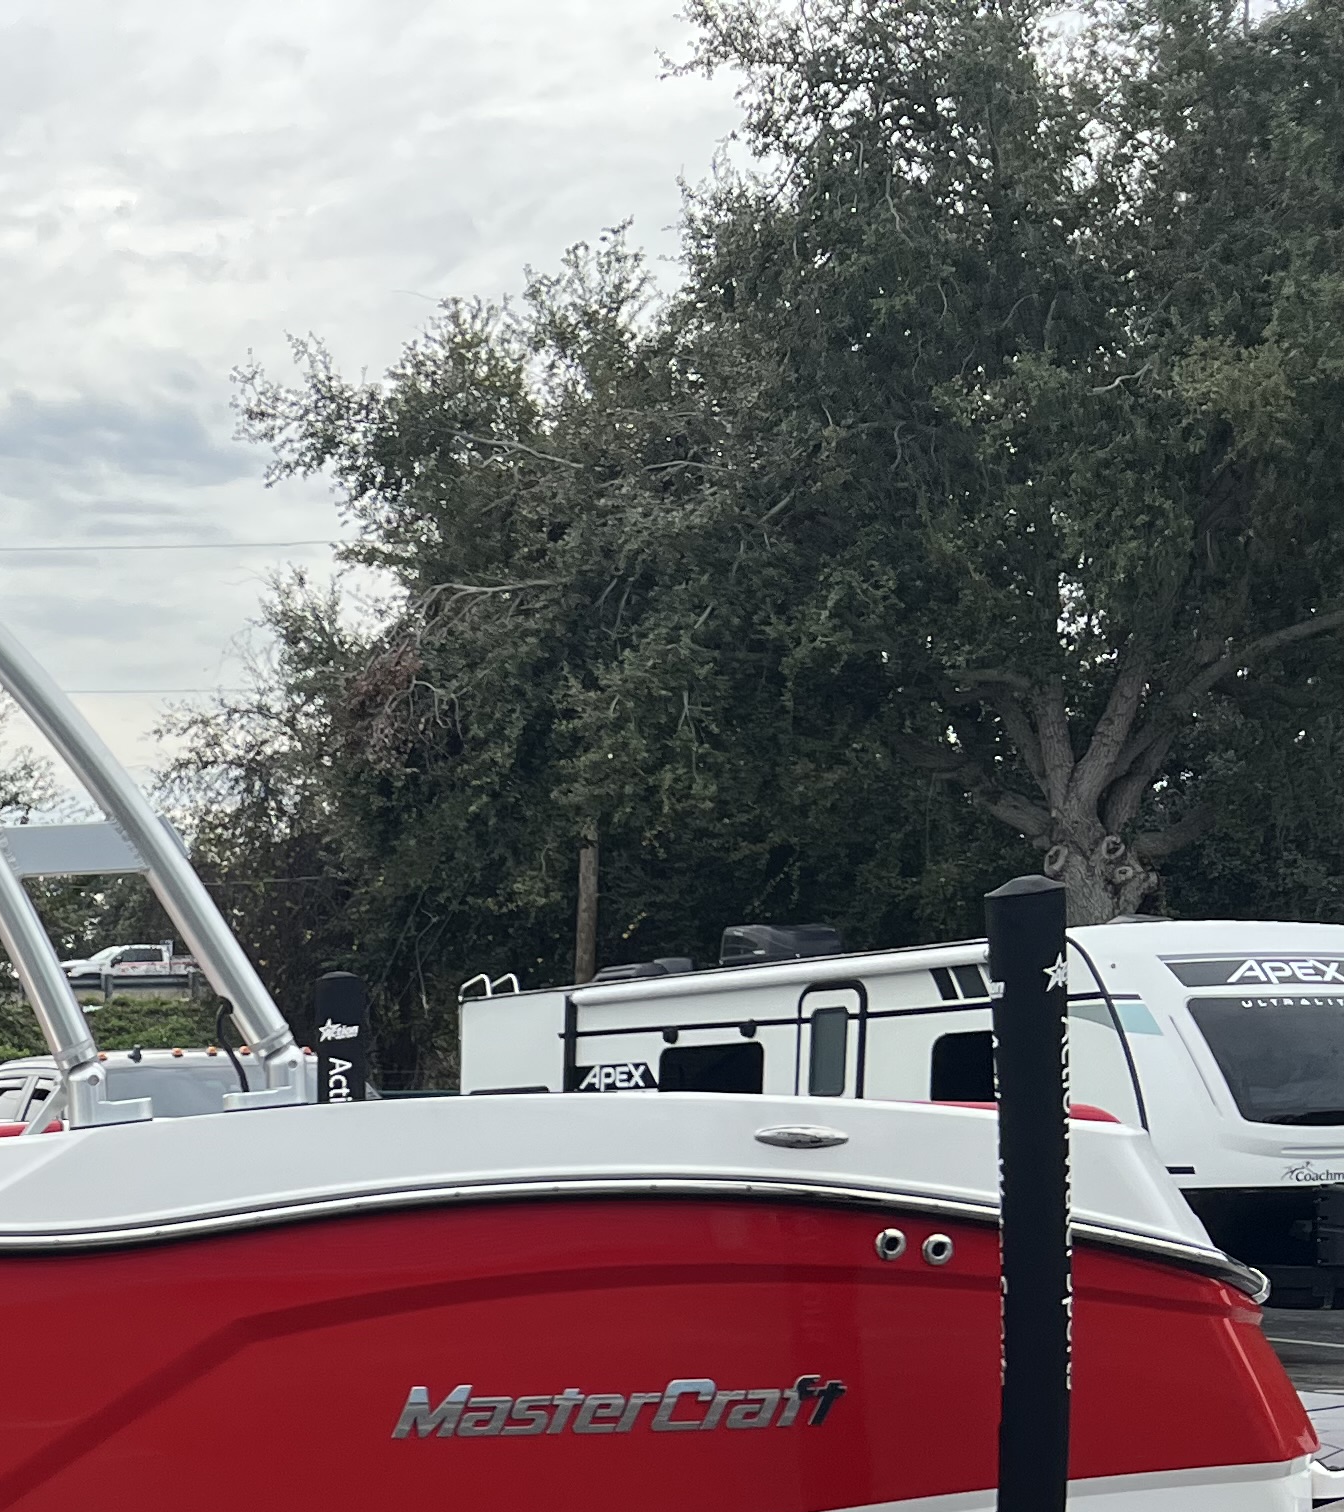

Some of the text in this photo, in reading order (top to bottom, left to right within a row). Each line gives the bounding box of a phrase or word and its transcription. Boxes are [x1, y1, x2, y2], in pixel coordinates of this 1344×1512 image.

[1226, 959, 1344, 985] APEX
[579, 1063, 646, 1093] APEX
[391, 1374, 848, 1439] MasterCraft
